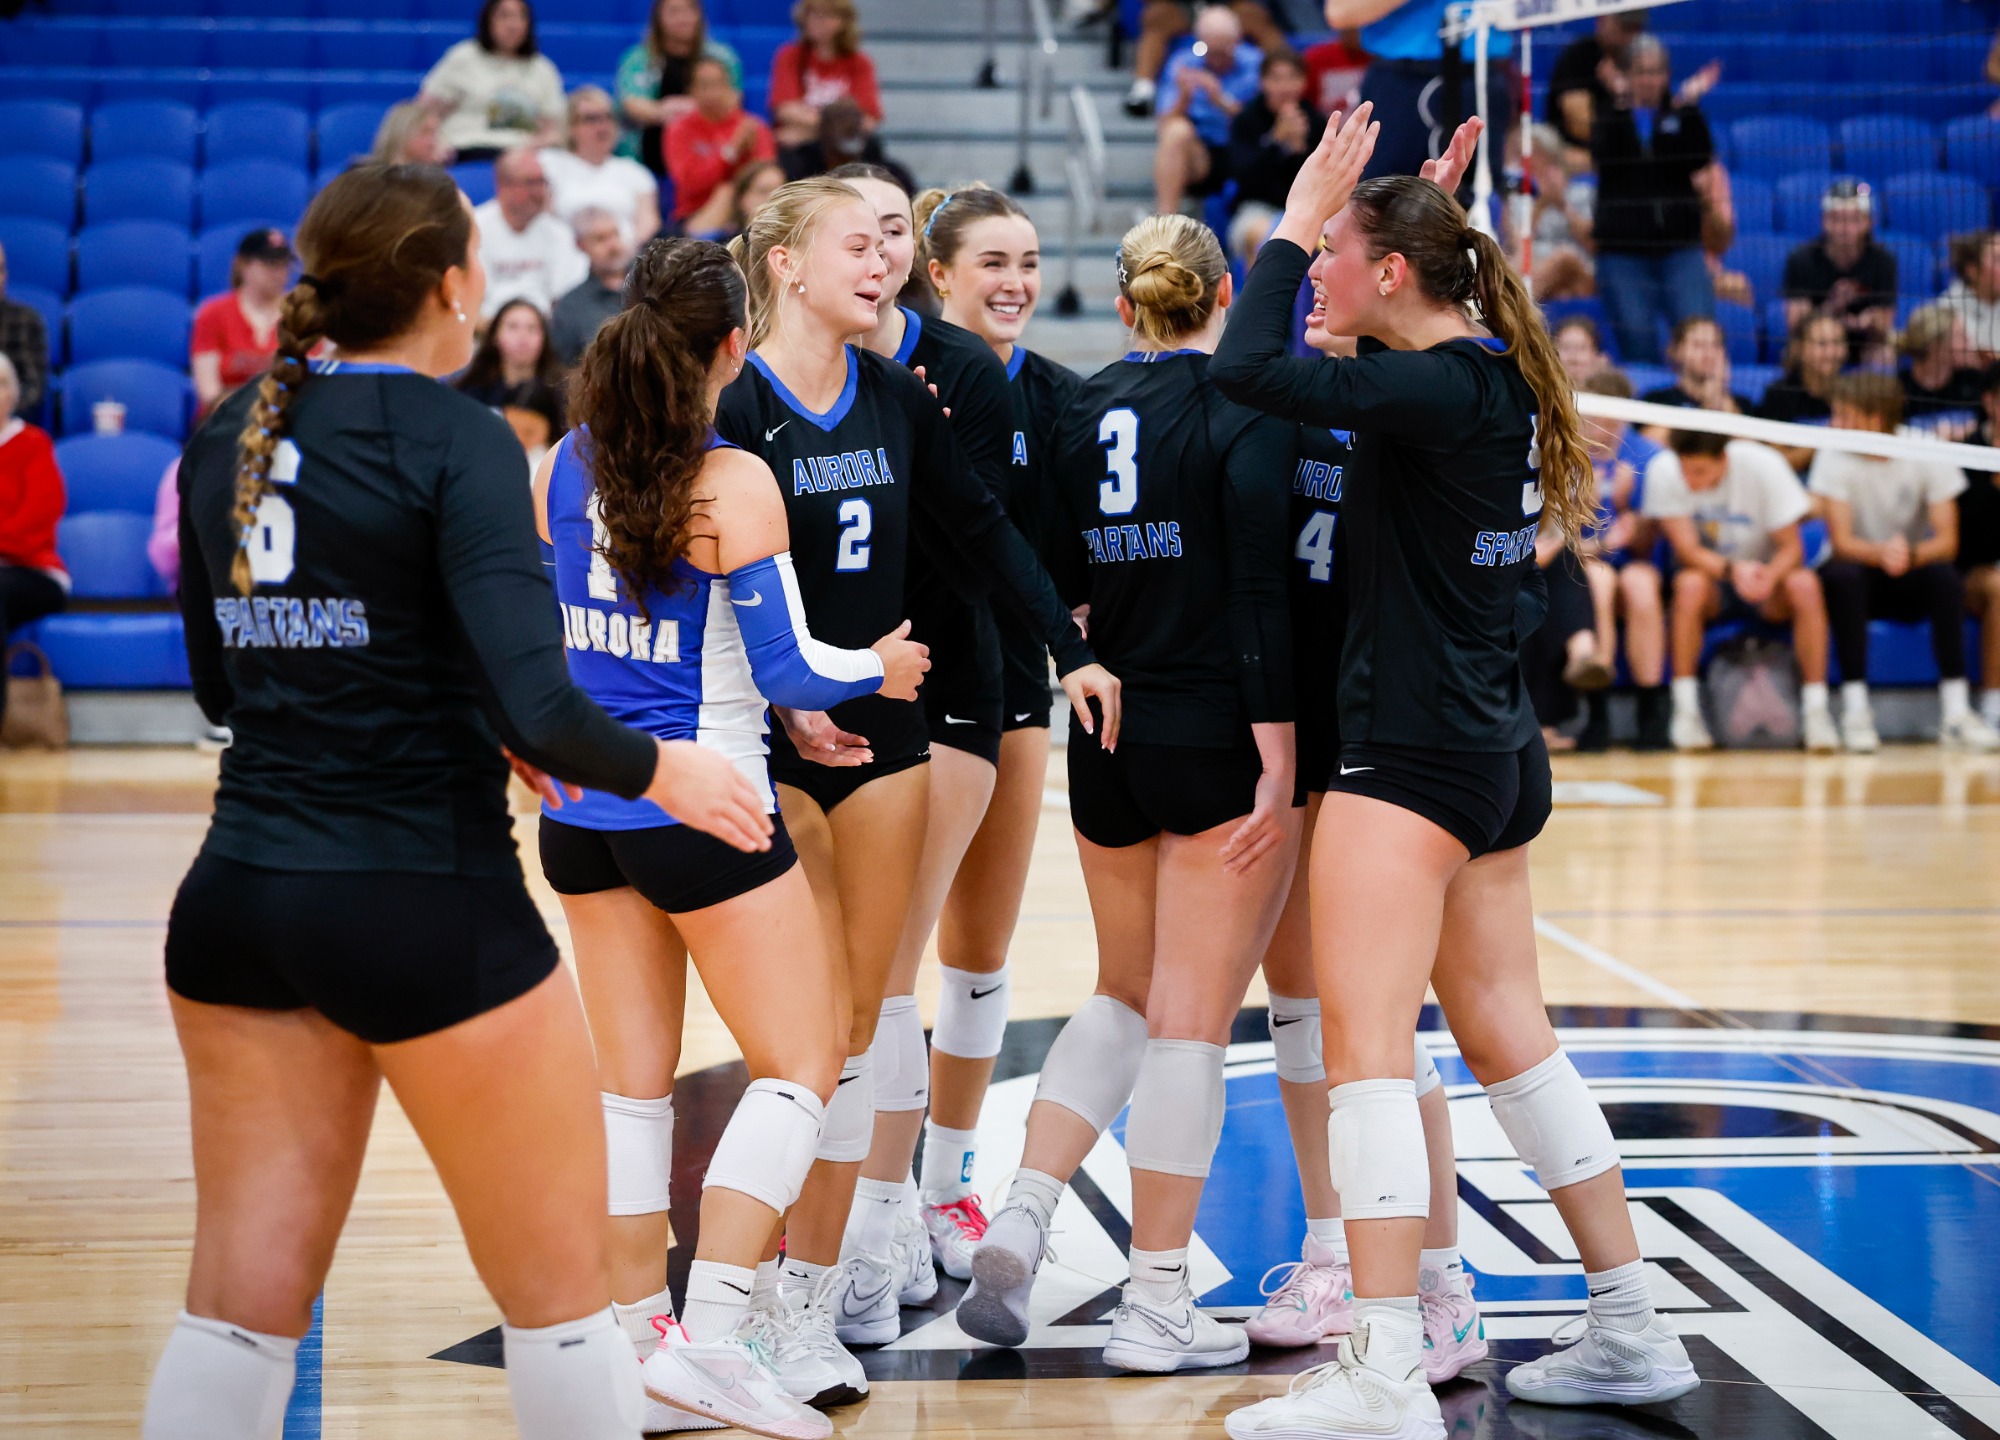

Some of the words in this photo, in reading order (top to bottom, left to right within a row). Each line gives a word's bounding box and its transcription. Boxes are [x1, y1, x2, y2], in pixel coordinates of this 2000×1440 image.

[793, 447, 894, 496] AURORA
[1097, 407, 1140, 517] 3
[1293, 458, 1343, 502] URO
[246, 436, 303, 586] 6
[835, 497, 872, 572] 2
[1081, 521, 1182, 563] PARTANS
[1294, 508, 1338, 583] 4
[1471, 520, 1540, 567] SPARTA
